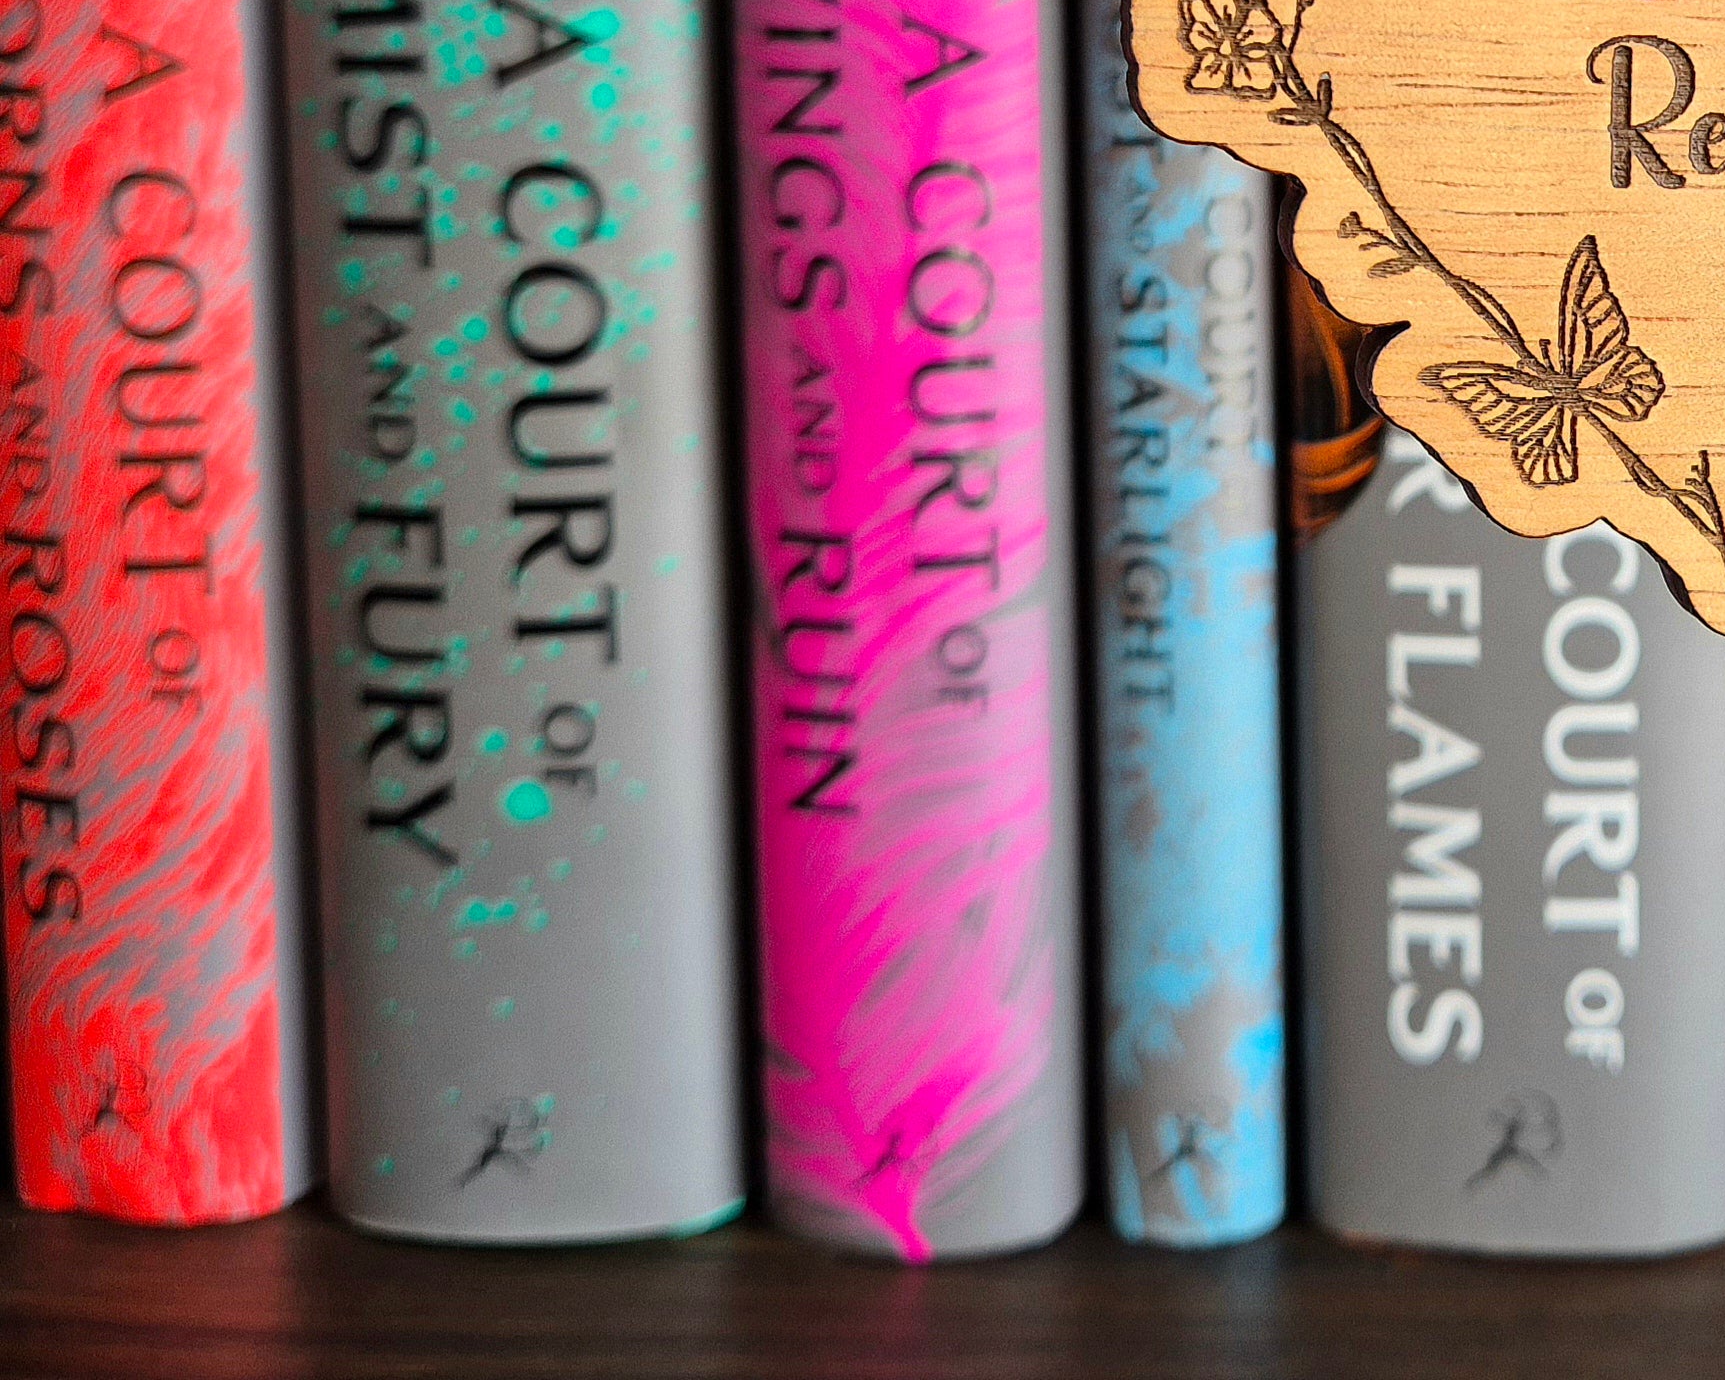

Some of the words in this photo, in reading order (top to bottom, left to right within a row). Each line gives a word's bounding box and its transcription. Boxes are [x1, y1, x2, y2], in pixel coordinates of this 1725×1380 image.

[98, 24, 188, 108] A
[900, 13, 989, 100] A
[108, 170, 215, 595] COURT
[364, 306, 417, 463] AND
[498, 162, 620, 663] COURT
[790, 347, 840, 496] AND
[904, 161, 1000, 591] COURT
[1202, 193, 1257, 456] COURT
[1114, 272, 1178, 718] STARLIGHT
[5, 532, 84, 921] ROSES
[145, 628, 204, 710] OF
[354, 500, 458, 868] FURY
[536, 703, 600, 795] OF
[776, 528, 862, 816] RUIN
[934, 623, 990, 718] OF
[1541, 523, 1642, 958] COURT
[1383, 563, 1484, 1066] FLAMES
[1563, 968, 1626, 1077] OF
